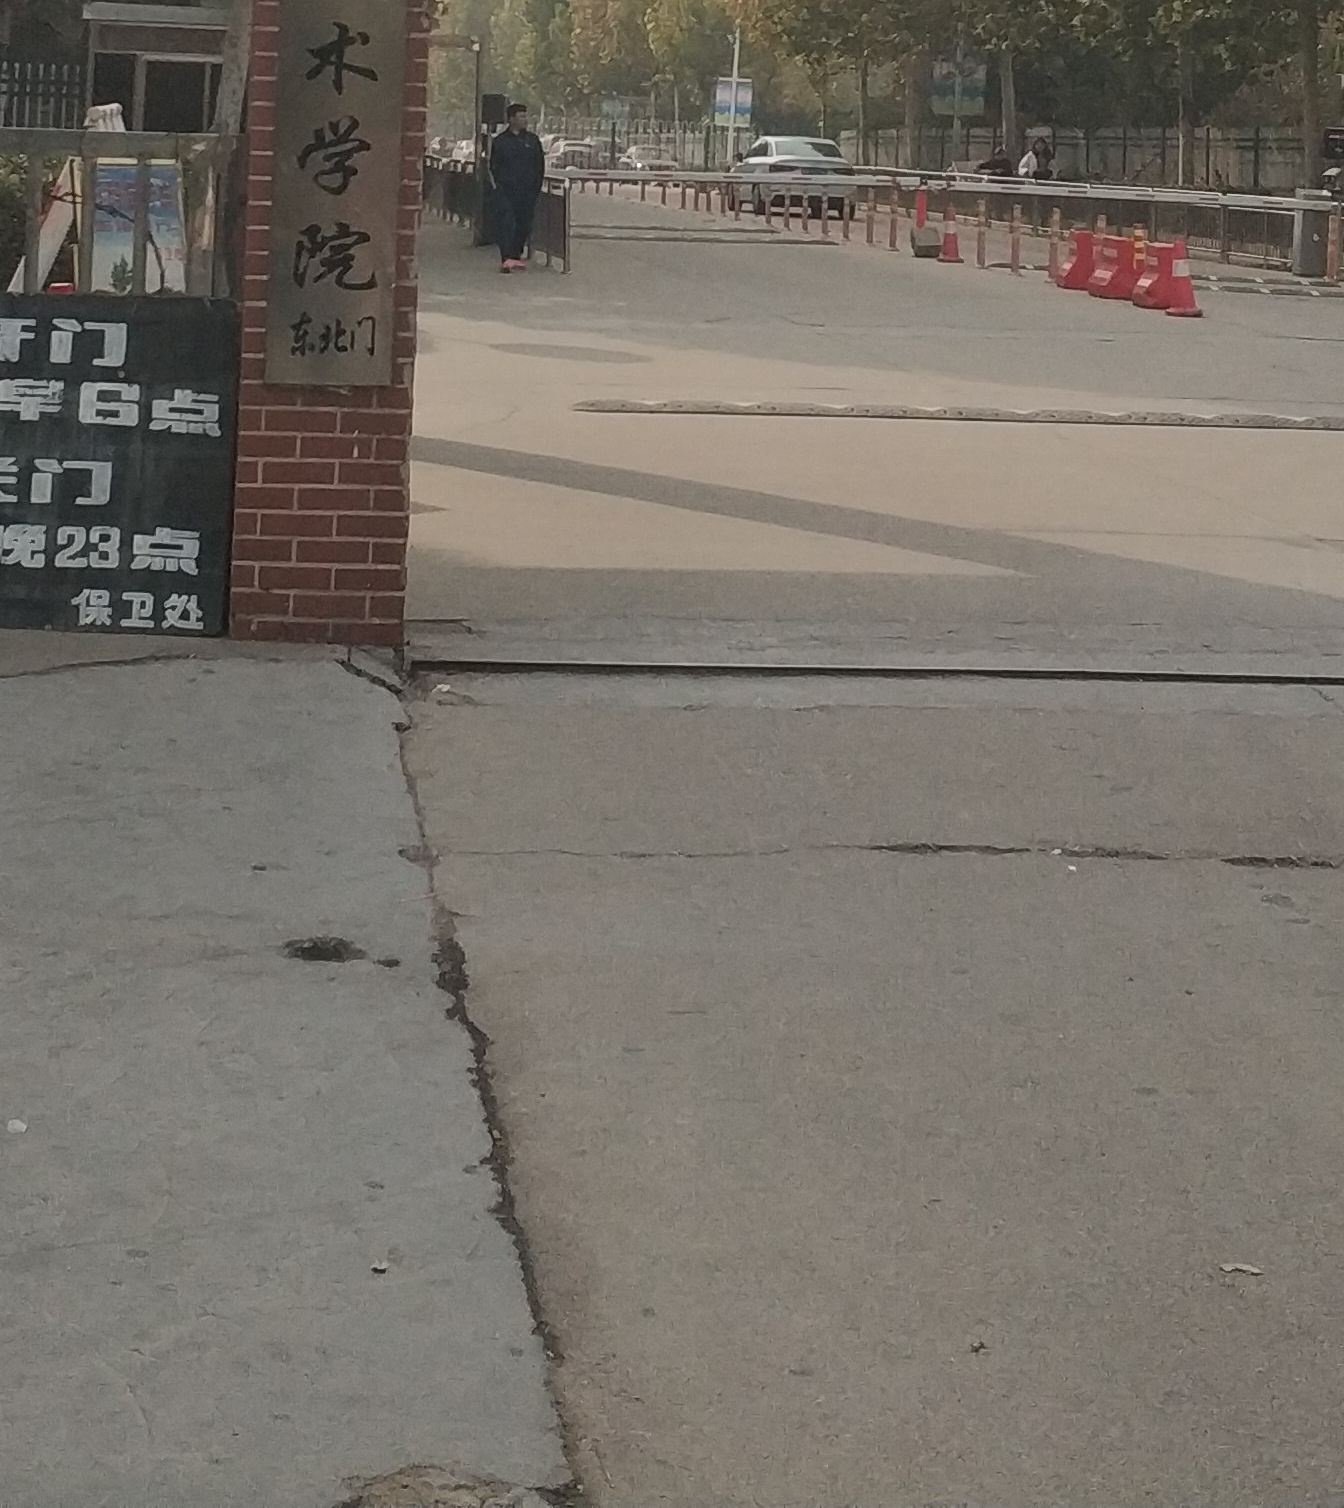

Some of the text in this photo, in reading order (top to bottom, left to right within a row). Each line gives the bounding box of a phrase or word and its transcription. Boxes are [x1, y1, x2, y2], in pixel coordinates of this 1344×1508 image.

[290, 311, 377, 357] 东北门
[71, 588, 205, 630] 保卫处
